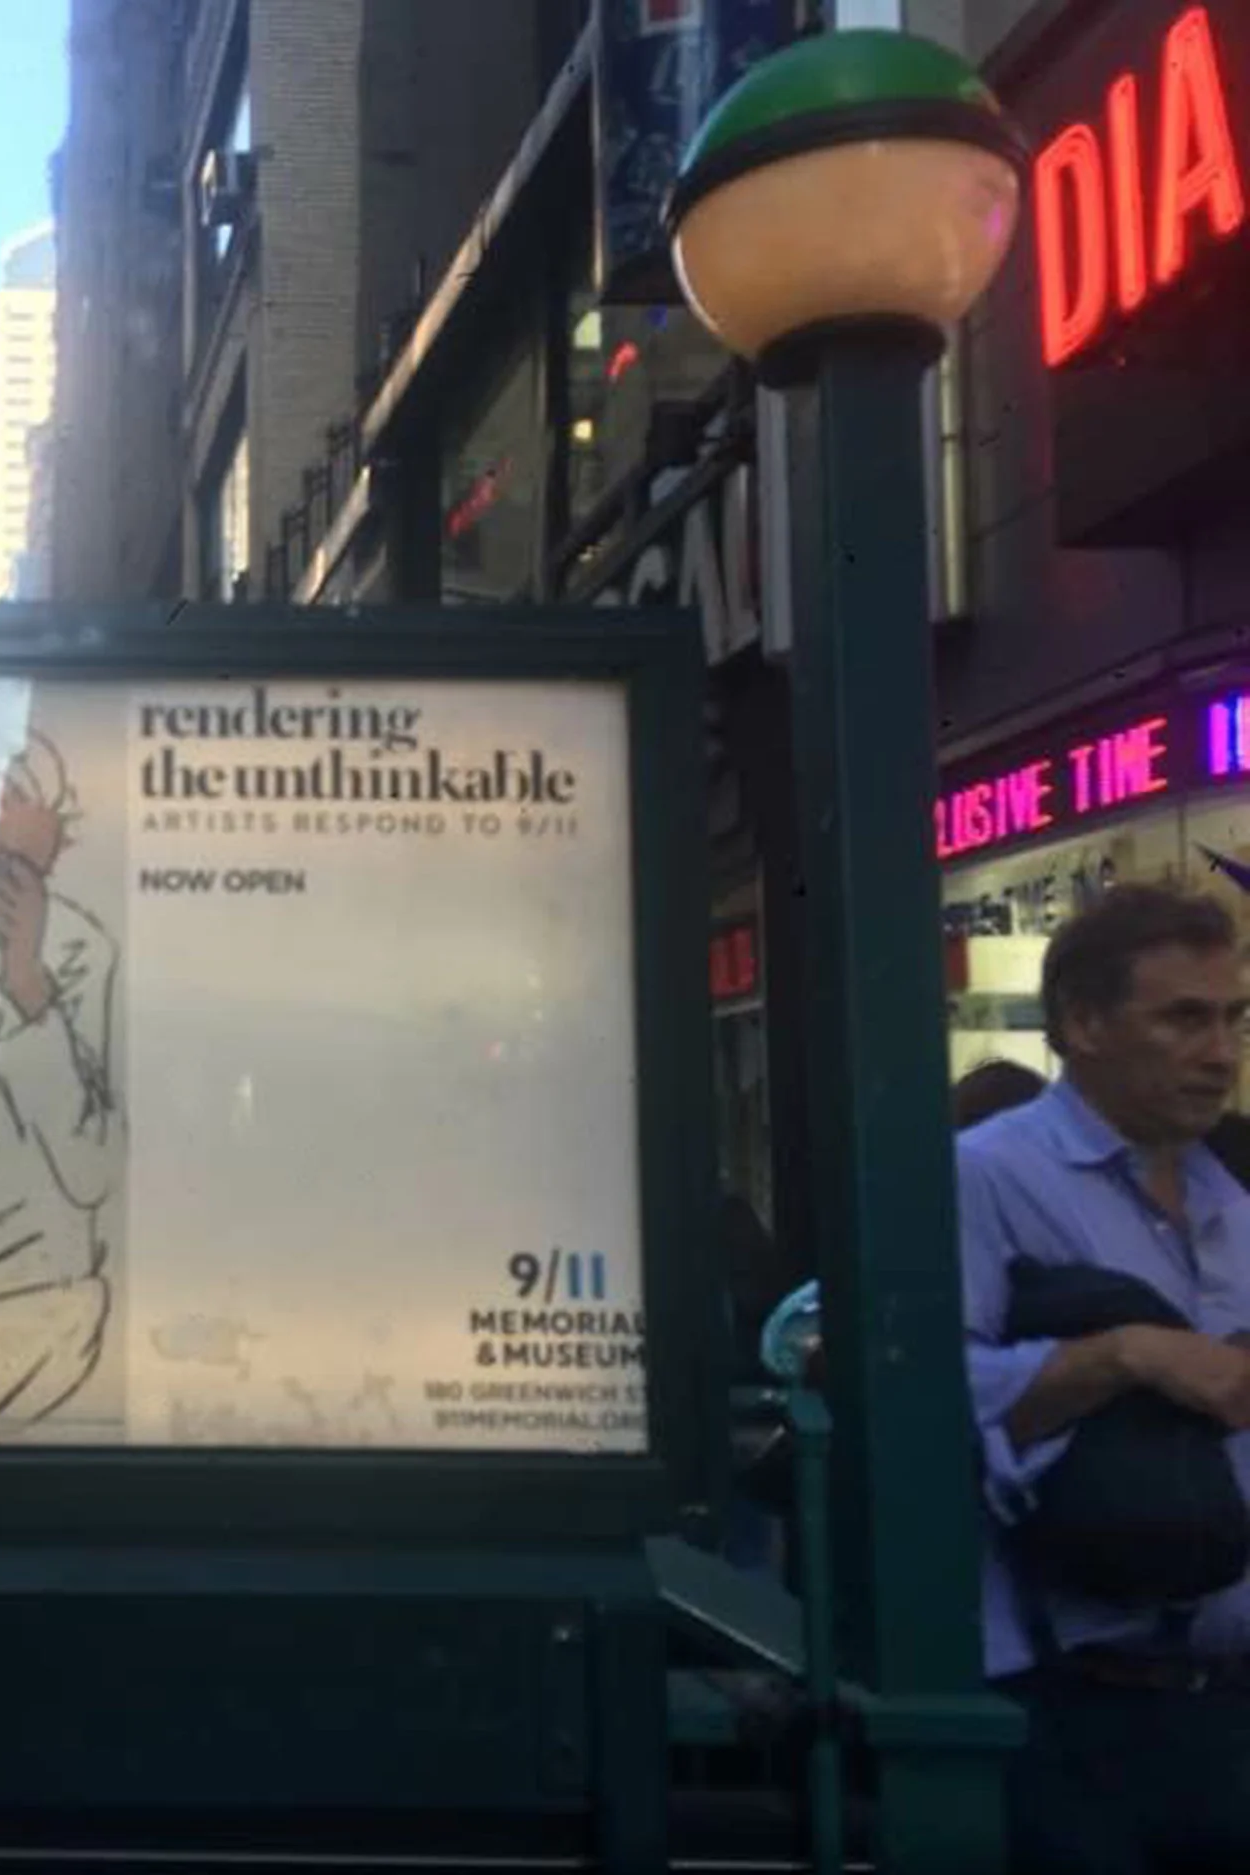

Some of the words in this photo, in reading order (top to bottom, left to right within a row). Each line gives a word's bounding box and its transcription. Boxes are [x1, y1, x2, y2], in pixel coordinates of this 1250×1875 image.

[1034, 6, 1245, 368] DIA
[140, 687, 422, 751] rendering
[140, 746, 228, 799] the
[234, 746, 576, 803] unthinkable
[1068, 717, 1168, 813] TIME
[142, 811, 278, 834] ARTISTS
[293, 811, 446, 835] RESPOND
[462, 812, 501, 835] TO
[140, 869, 216, 893] NOW
[223, 869, 306, 893] OPEN
[508, 1246, 605, 1304] 9/11
[475, 1341, 496, 1367] &
[503, 1342, 645, 1368] MUSEUM
